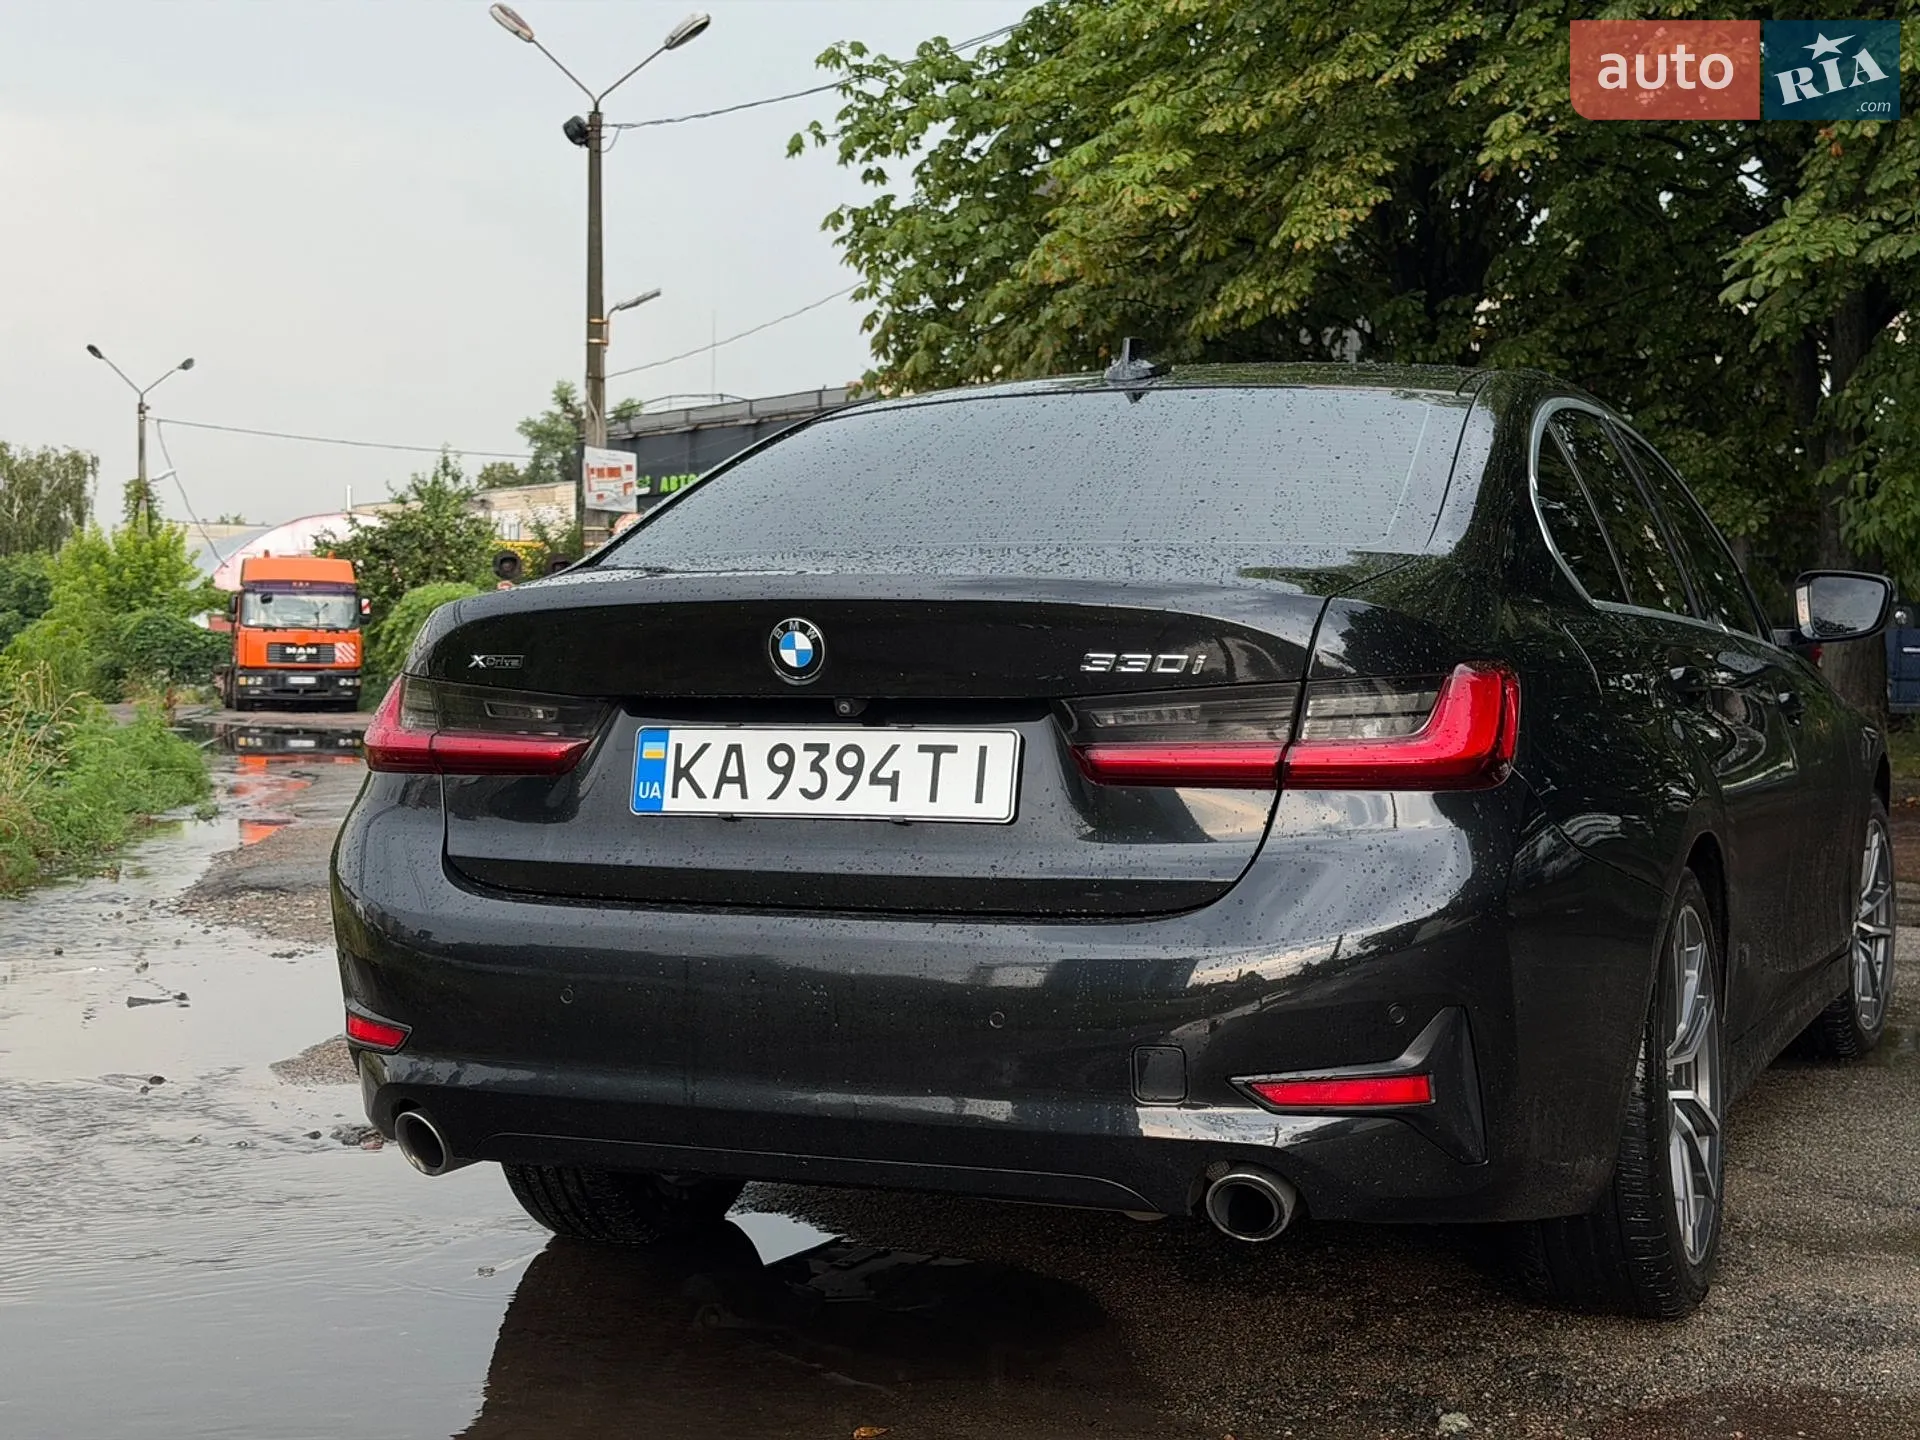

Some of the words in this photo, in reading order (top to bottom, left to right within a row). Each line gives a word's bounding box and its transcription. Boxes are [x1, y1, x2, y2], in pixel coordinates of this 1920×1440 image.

[772, 620, 818, 640] BMW
[285, 646, 318, 655] MAN
[1079, 652, 1208, 675] 330i
[638, 781, 662, 800] UA
